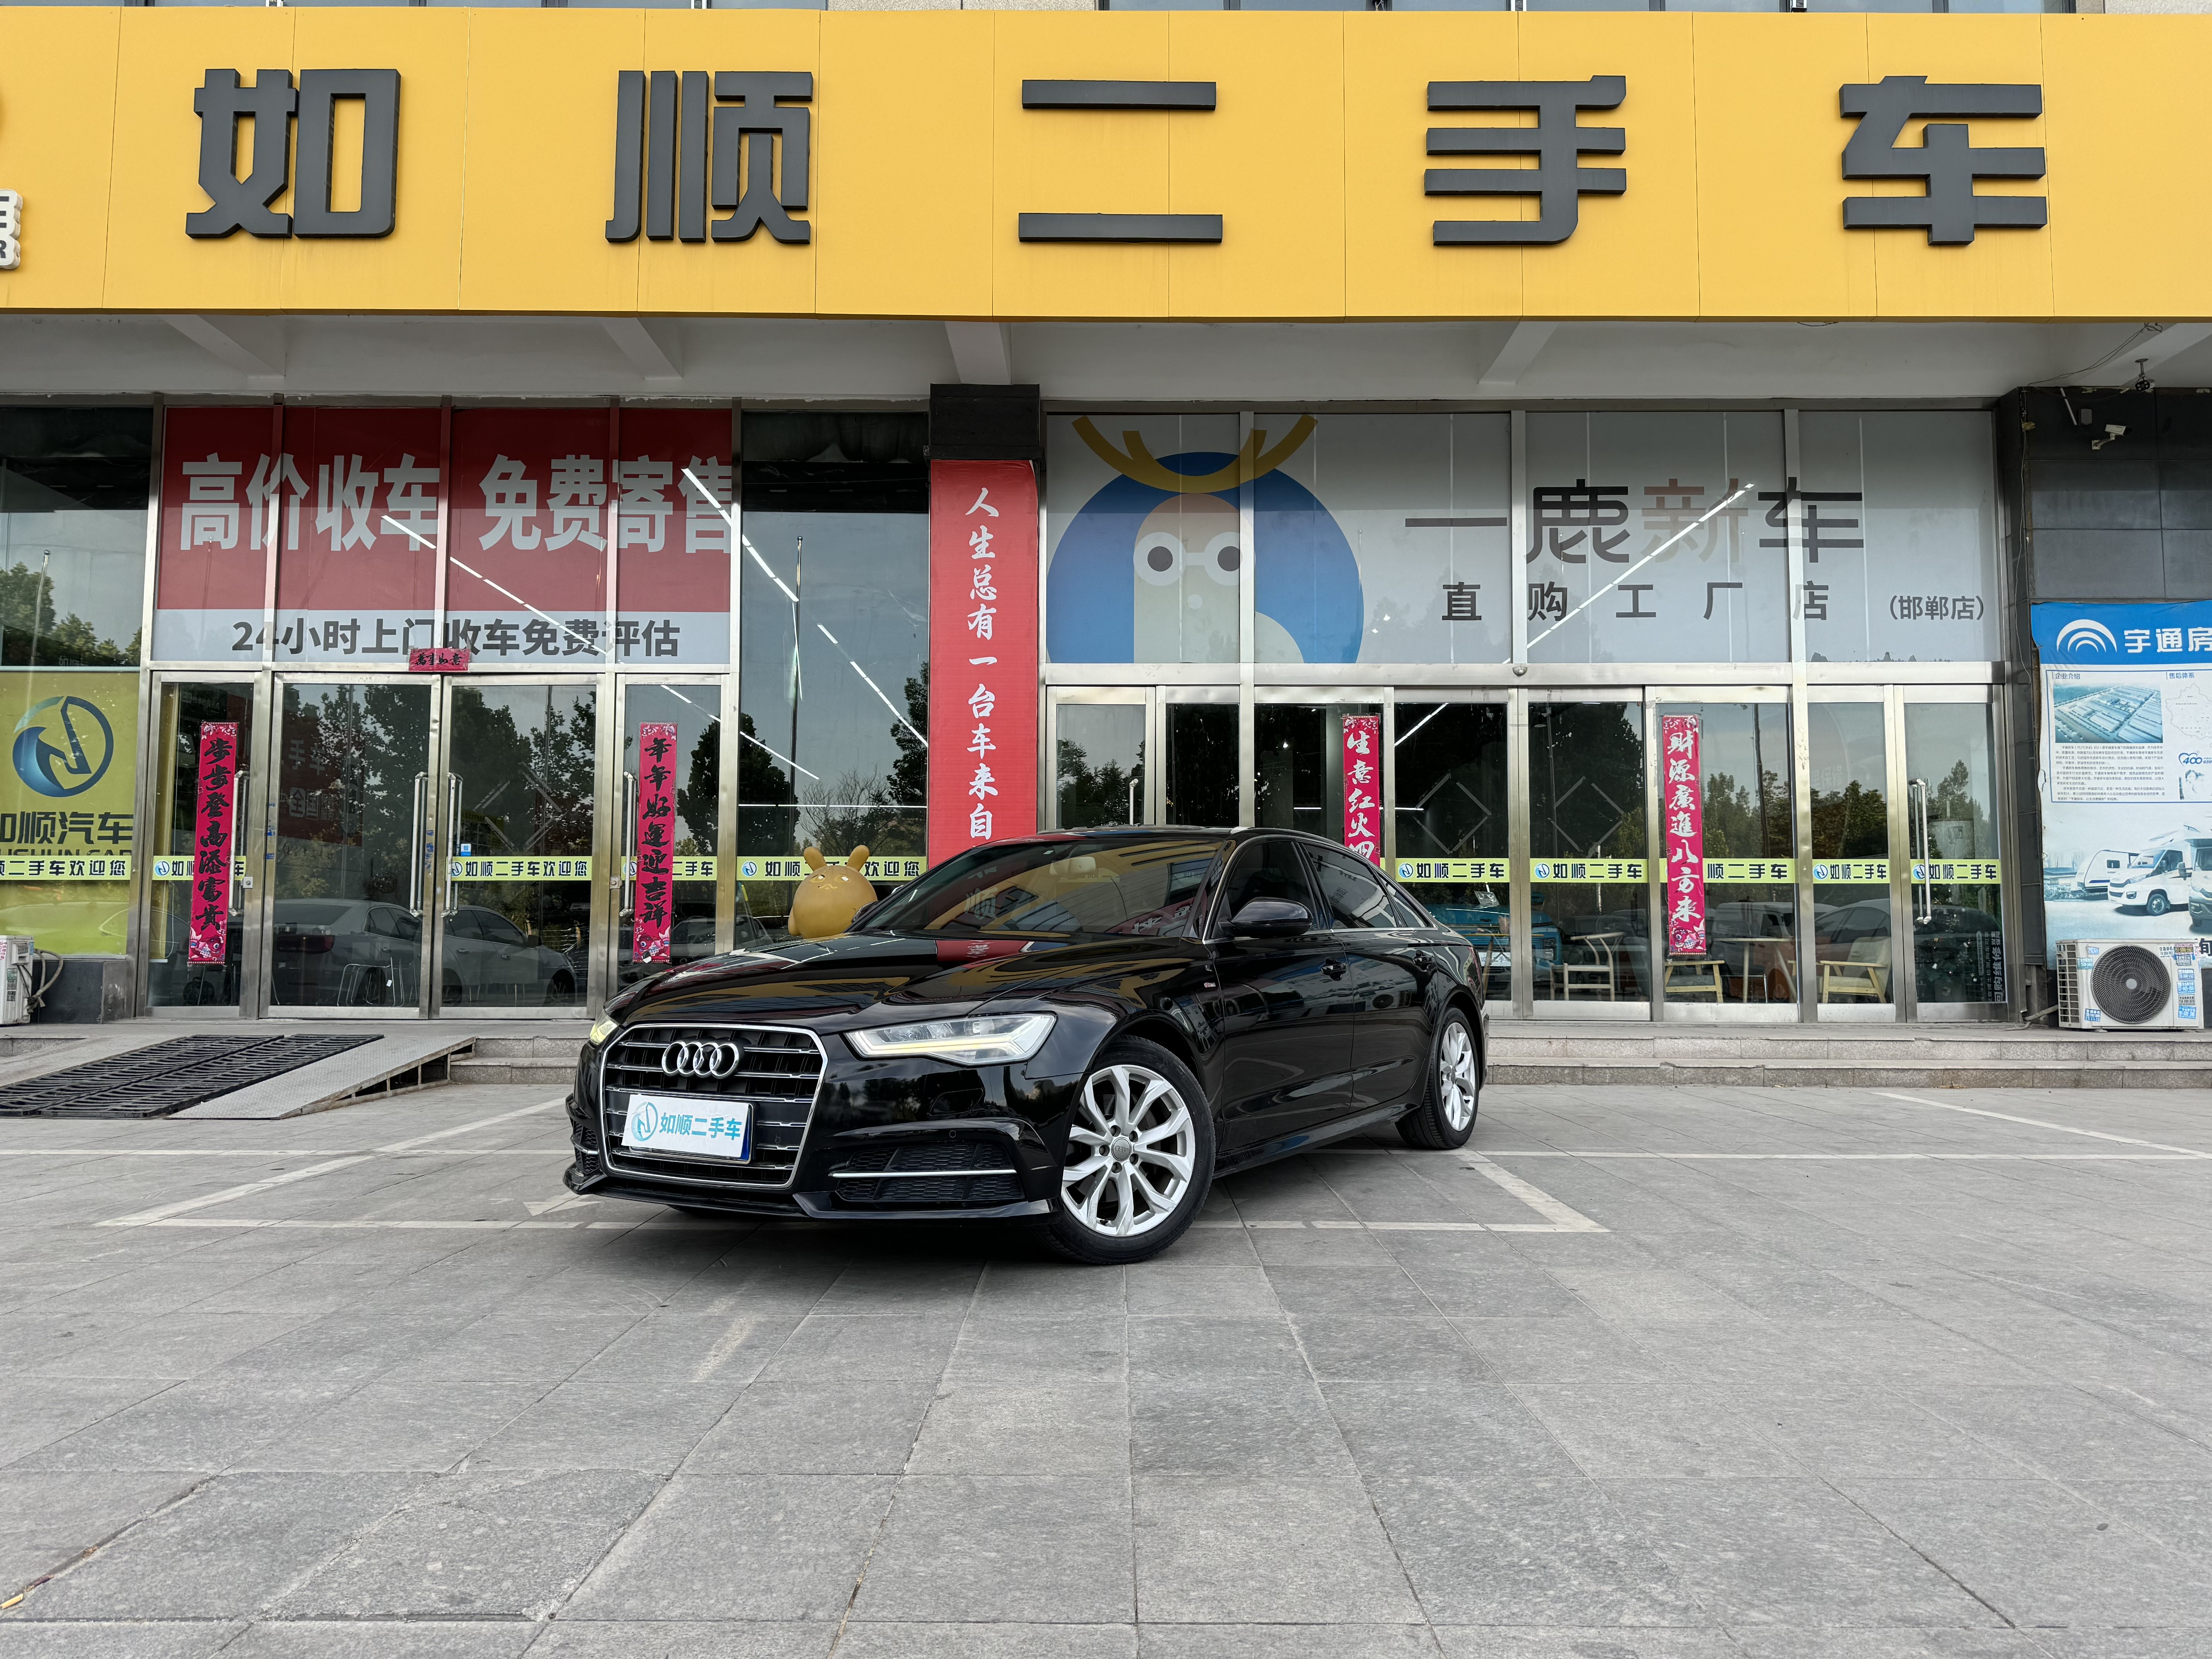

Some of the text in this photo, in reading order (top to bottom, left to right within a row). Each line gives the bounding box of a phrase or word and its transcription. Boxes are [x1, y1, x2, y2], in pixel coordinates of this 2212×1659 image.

[185, 69, 2047, 246] 如顺二手车
[180, 453, 731, 553] 高价收车 免费寄售
[1405, 477, 1863, 564] 一鹿新车
[1442, 580, 1829, 621] 直购工厂店
[1888, 594, 1985, 621] （邯郸店）
[232, 617, 680, 658] 24小时上门收车免费评估
[2124, 626, 2212, 653] 宇通房
[965, 487, 999, 840] 人生总有一台车来自
[465, 860, 587, 876] 如顺二手车欢迎您
[764, 861, 919, 877] 如顺欢迎您
[1416, 863, 1504, 878] 如顺二手车
[1553, 863, 1642, 879] 如顺二手车
[1707, 863, 1788, 879] 顺二手车
[1830, 864, 1887, 880] 如顺二手车
[1929, 864, 1997, 880] 如顺二手车
[659, 1112, 742, 1140] 如顺二手车
